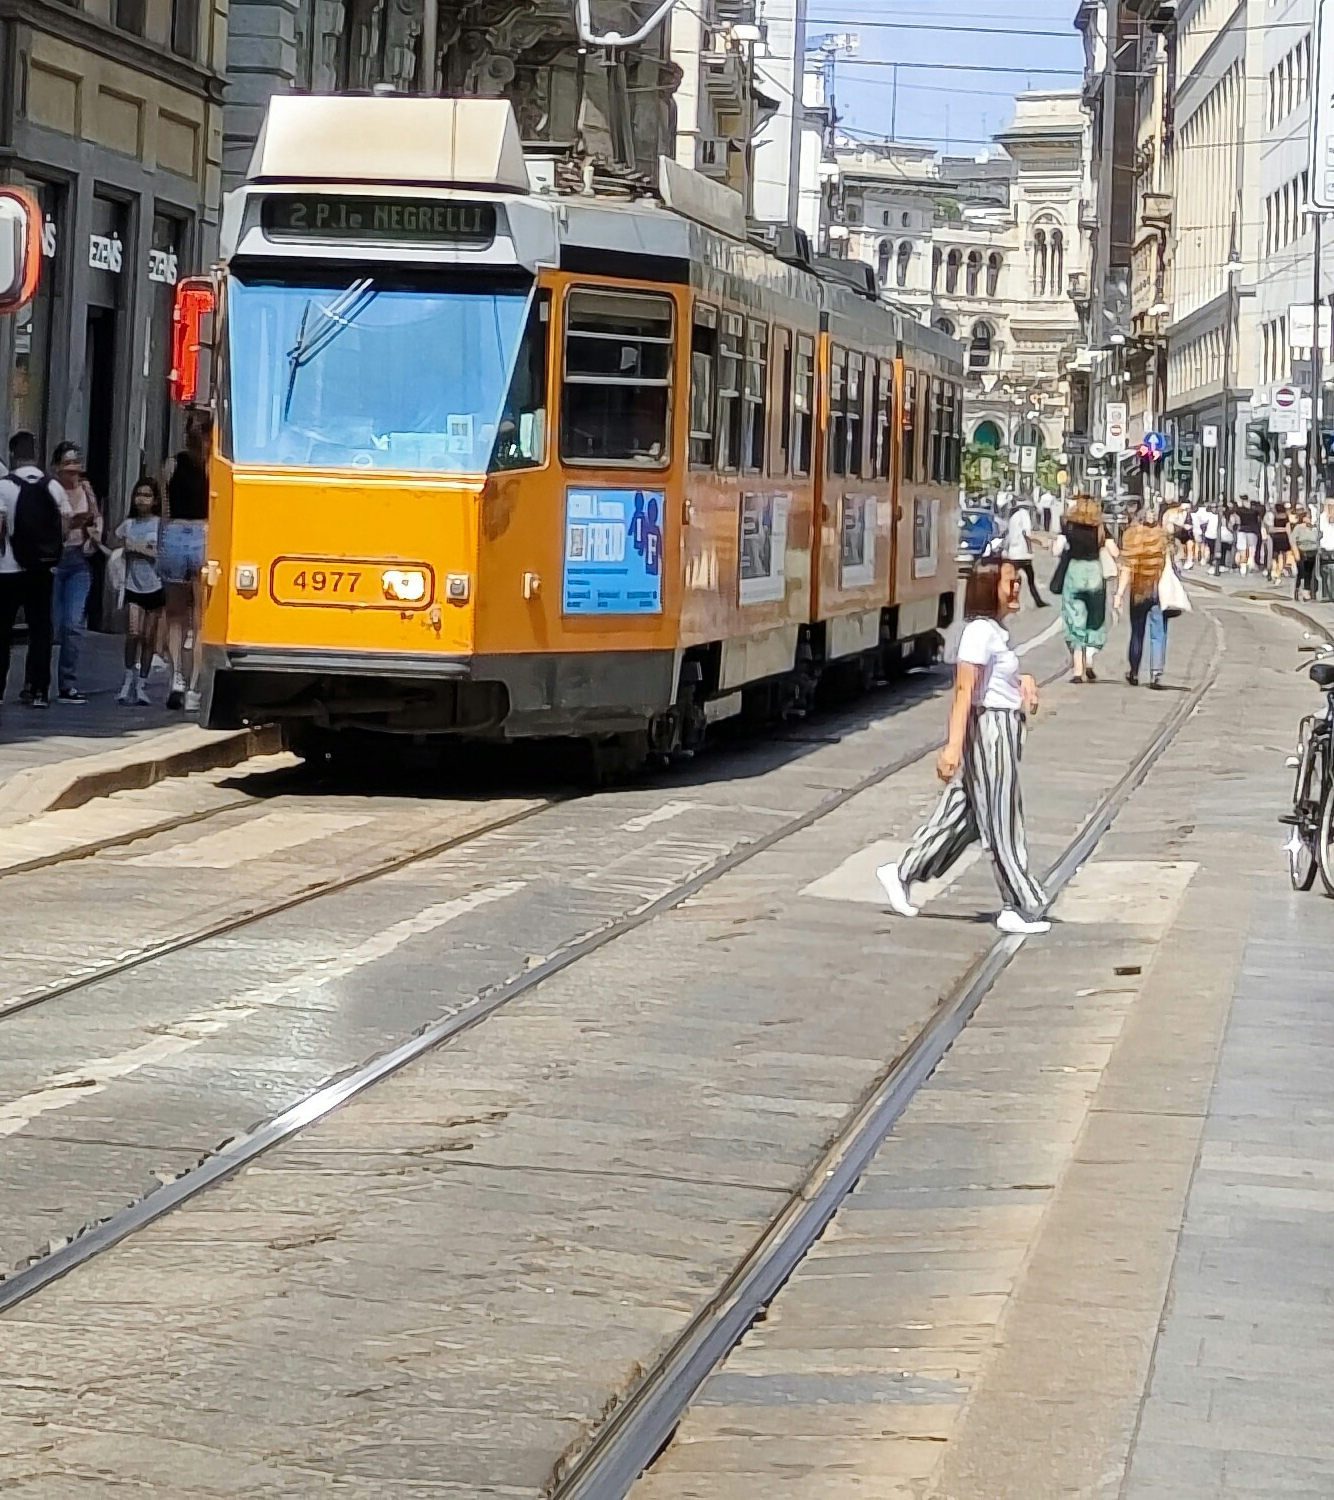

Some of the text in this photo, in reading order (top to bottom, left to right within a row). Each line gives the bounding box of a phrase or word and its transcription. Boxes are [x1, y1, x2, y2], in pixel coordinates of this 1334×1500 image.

[289, 202, 308, 226] 2
[373, 204, 483, 232] NEGRELLI
[293, 570, 362, 594] 4977
